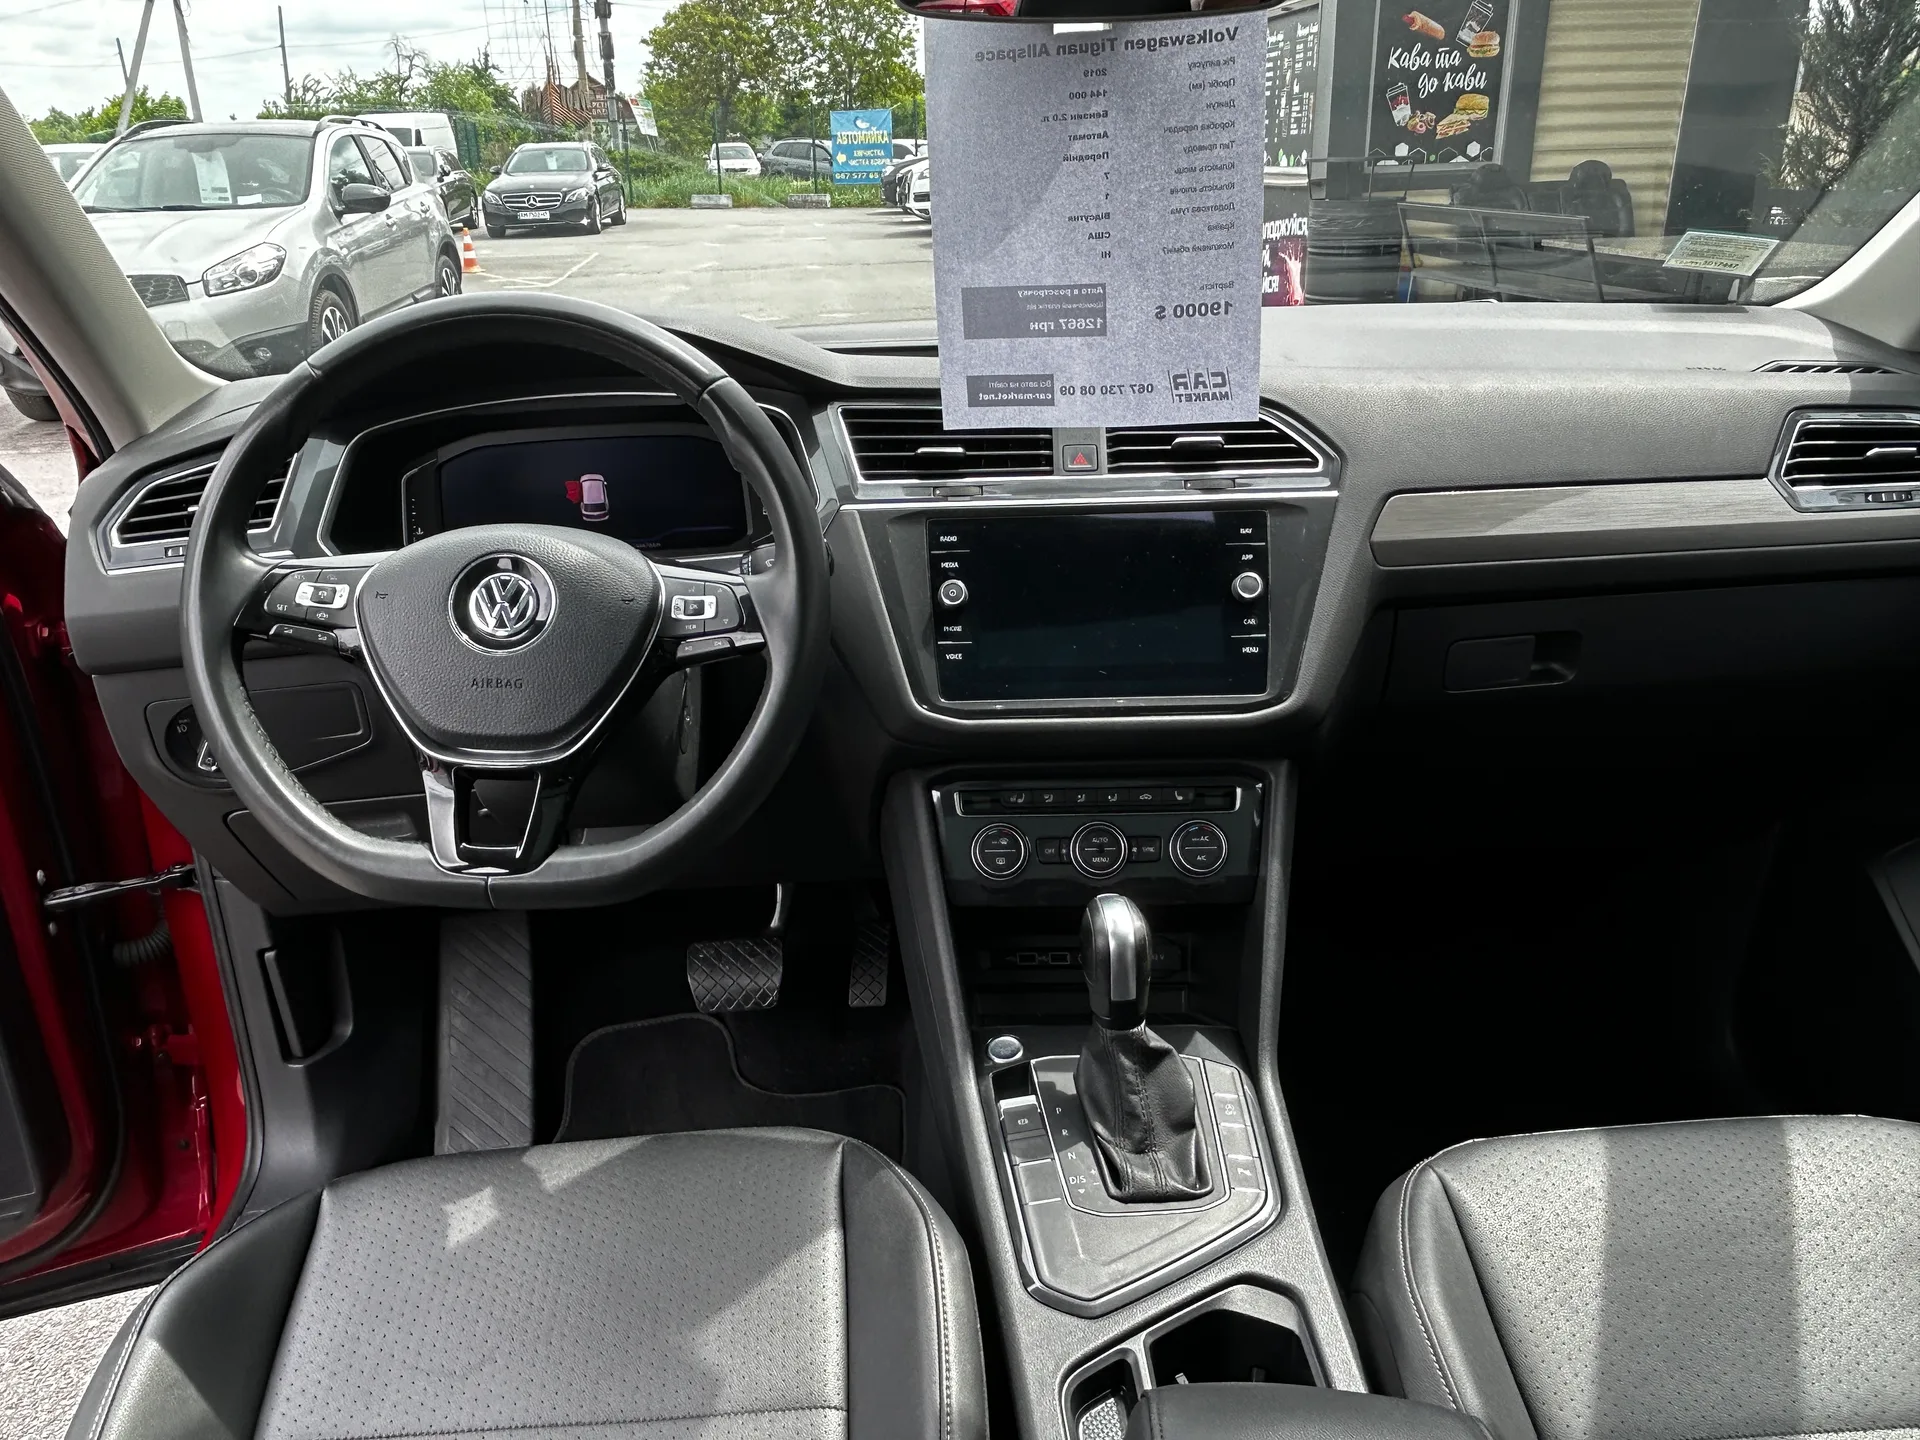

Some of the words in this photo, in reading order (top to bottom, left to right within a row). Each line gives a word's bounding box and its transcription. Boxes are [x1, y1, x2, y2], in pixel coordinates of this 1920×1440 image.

[1387, 43, 1432, 70] Кава
[1435, 47, 1462, 69] та
[1418, 73, 1438, 98] до
[1443, 63, 1487, 92] кави
[836, 127, 889, 145] АВТОМИЙКА
[471, 678, 523, 689] AIRBAG
[1068, 1152, 1076, 1160] N
[1069, 1176, 1086, 1184] D/S
